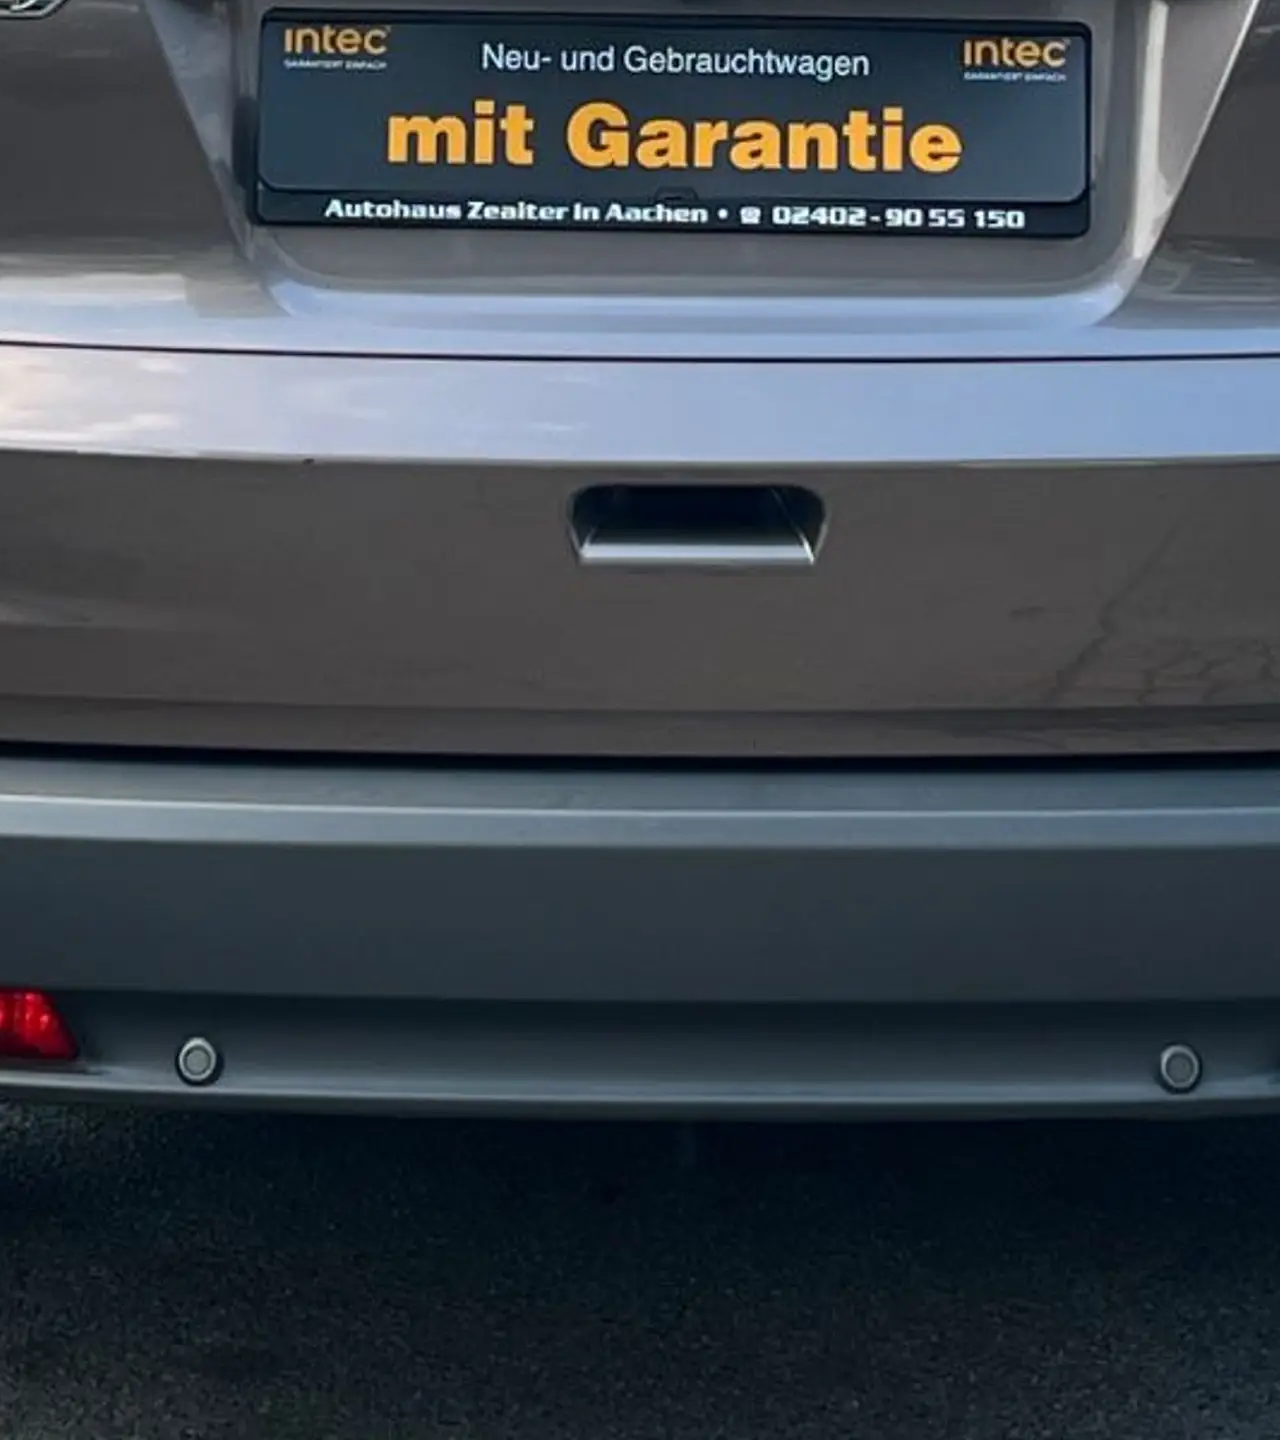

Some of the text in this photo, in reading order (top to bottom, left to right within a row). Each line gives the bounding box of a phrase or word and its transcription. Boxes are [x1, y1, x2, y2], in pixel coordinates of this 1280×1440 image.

[284, 25, 388, 55] intec
[963, 38, 1067, 68] intec
[481, 43, 871, 82] Neu- und Gebrauchtwagen
[387, 100, 964, 173] mit Garantie
[325, 199, 462, 219] Autohaus
[604, 202, 709, 224] Aachen
[928, 208, 966, 227] 55
[974, 210, 1026, 229] 150
